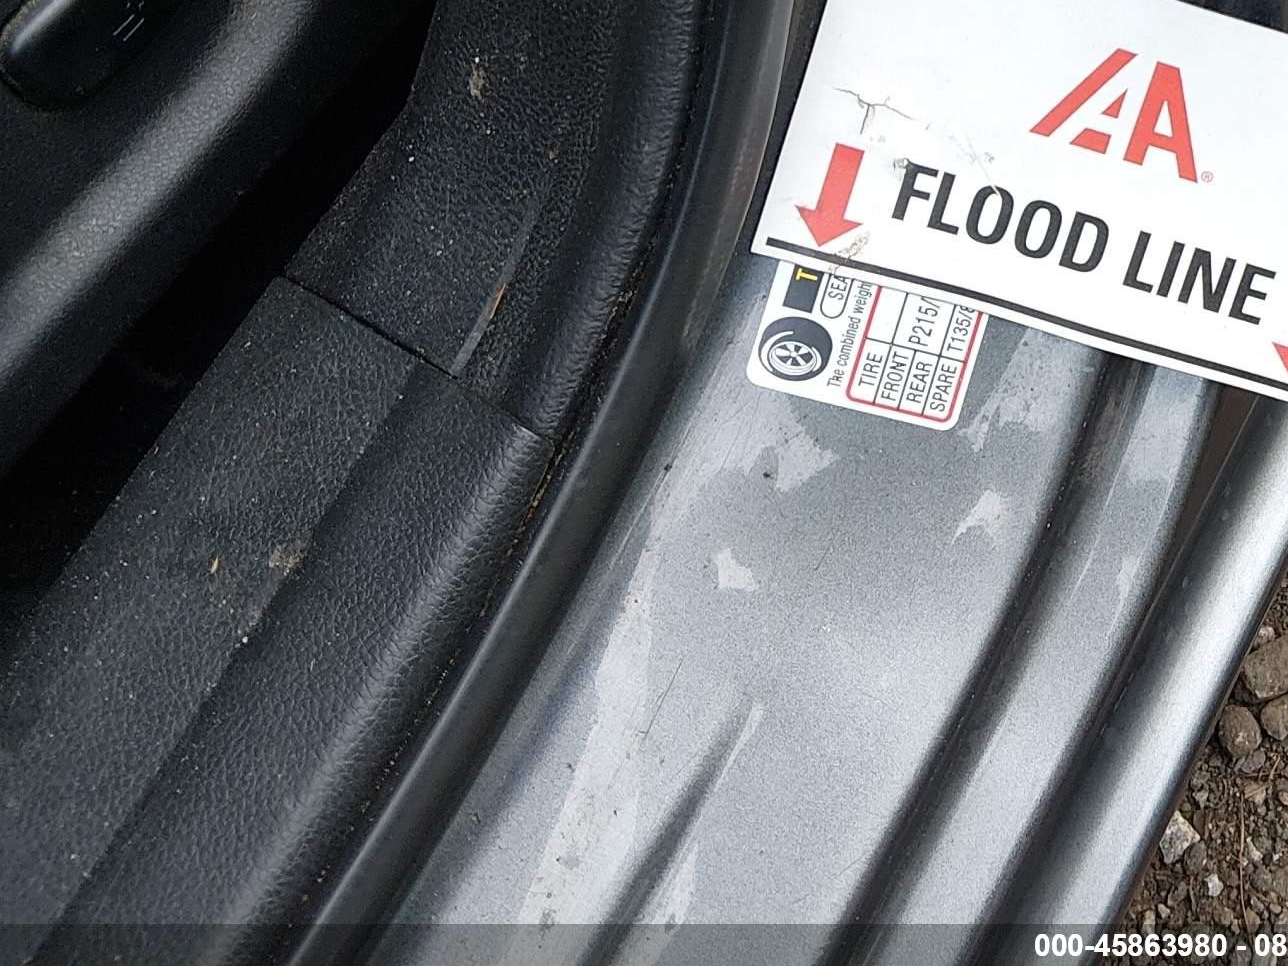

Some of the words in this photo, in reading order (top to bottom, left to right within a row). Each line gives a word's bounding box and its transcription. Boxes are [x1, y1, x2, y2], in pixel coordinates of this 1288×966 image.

[891, 157, 1110, 274] FLOOD
[1122, 231, 1277, 326] LINE
[826, 368, 845, 387] The
[837, 316, 861, 367] combined
[853, 282, 873, 314] weigh
[858, 352, 883, 387] TIRE
[881, 351, 909, 402] FRONT
[906, 361, 933, 404] REAR
[930, 364, 957, 412] SPARE
